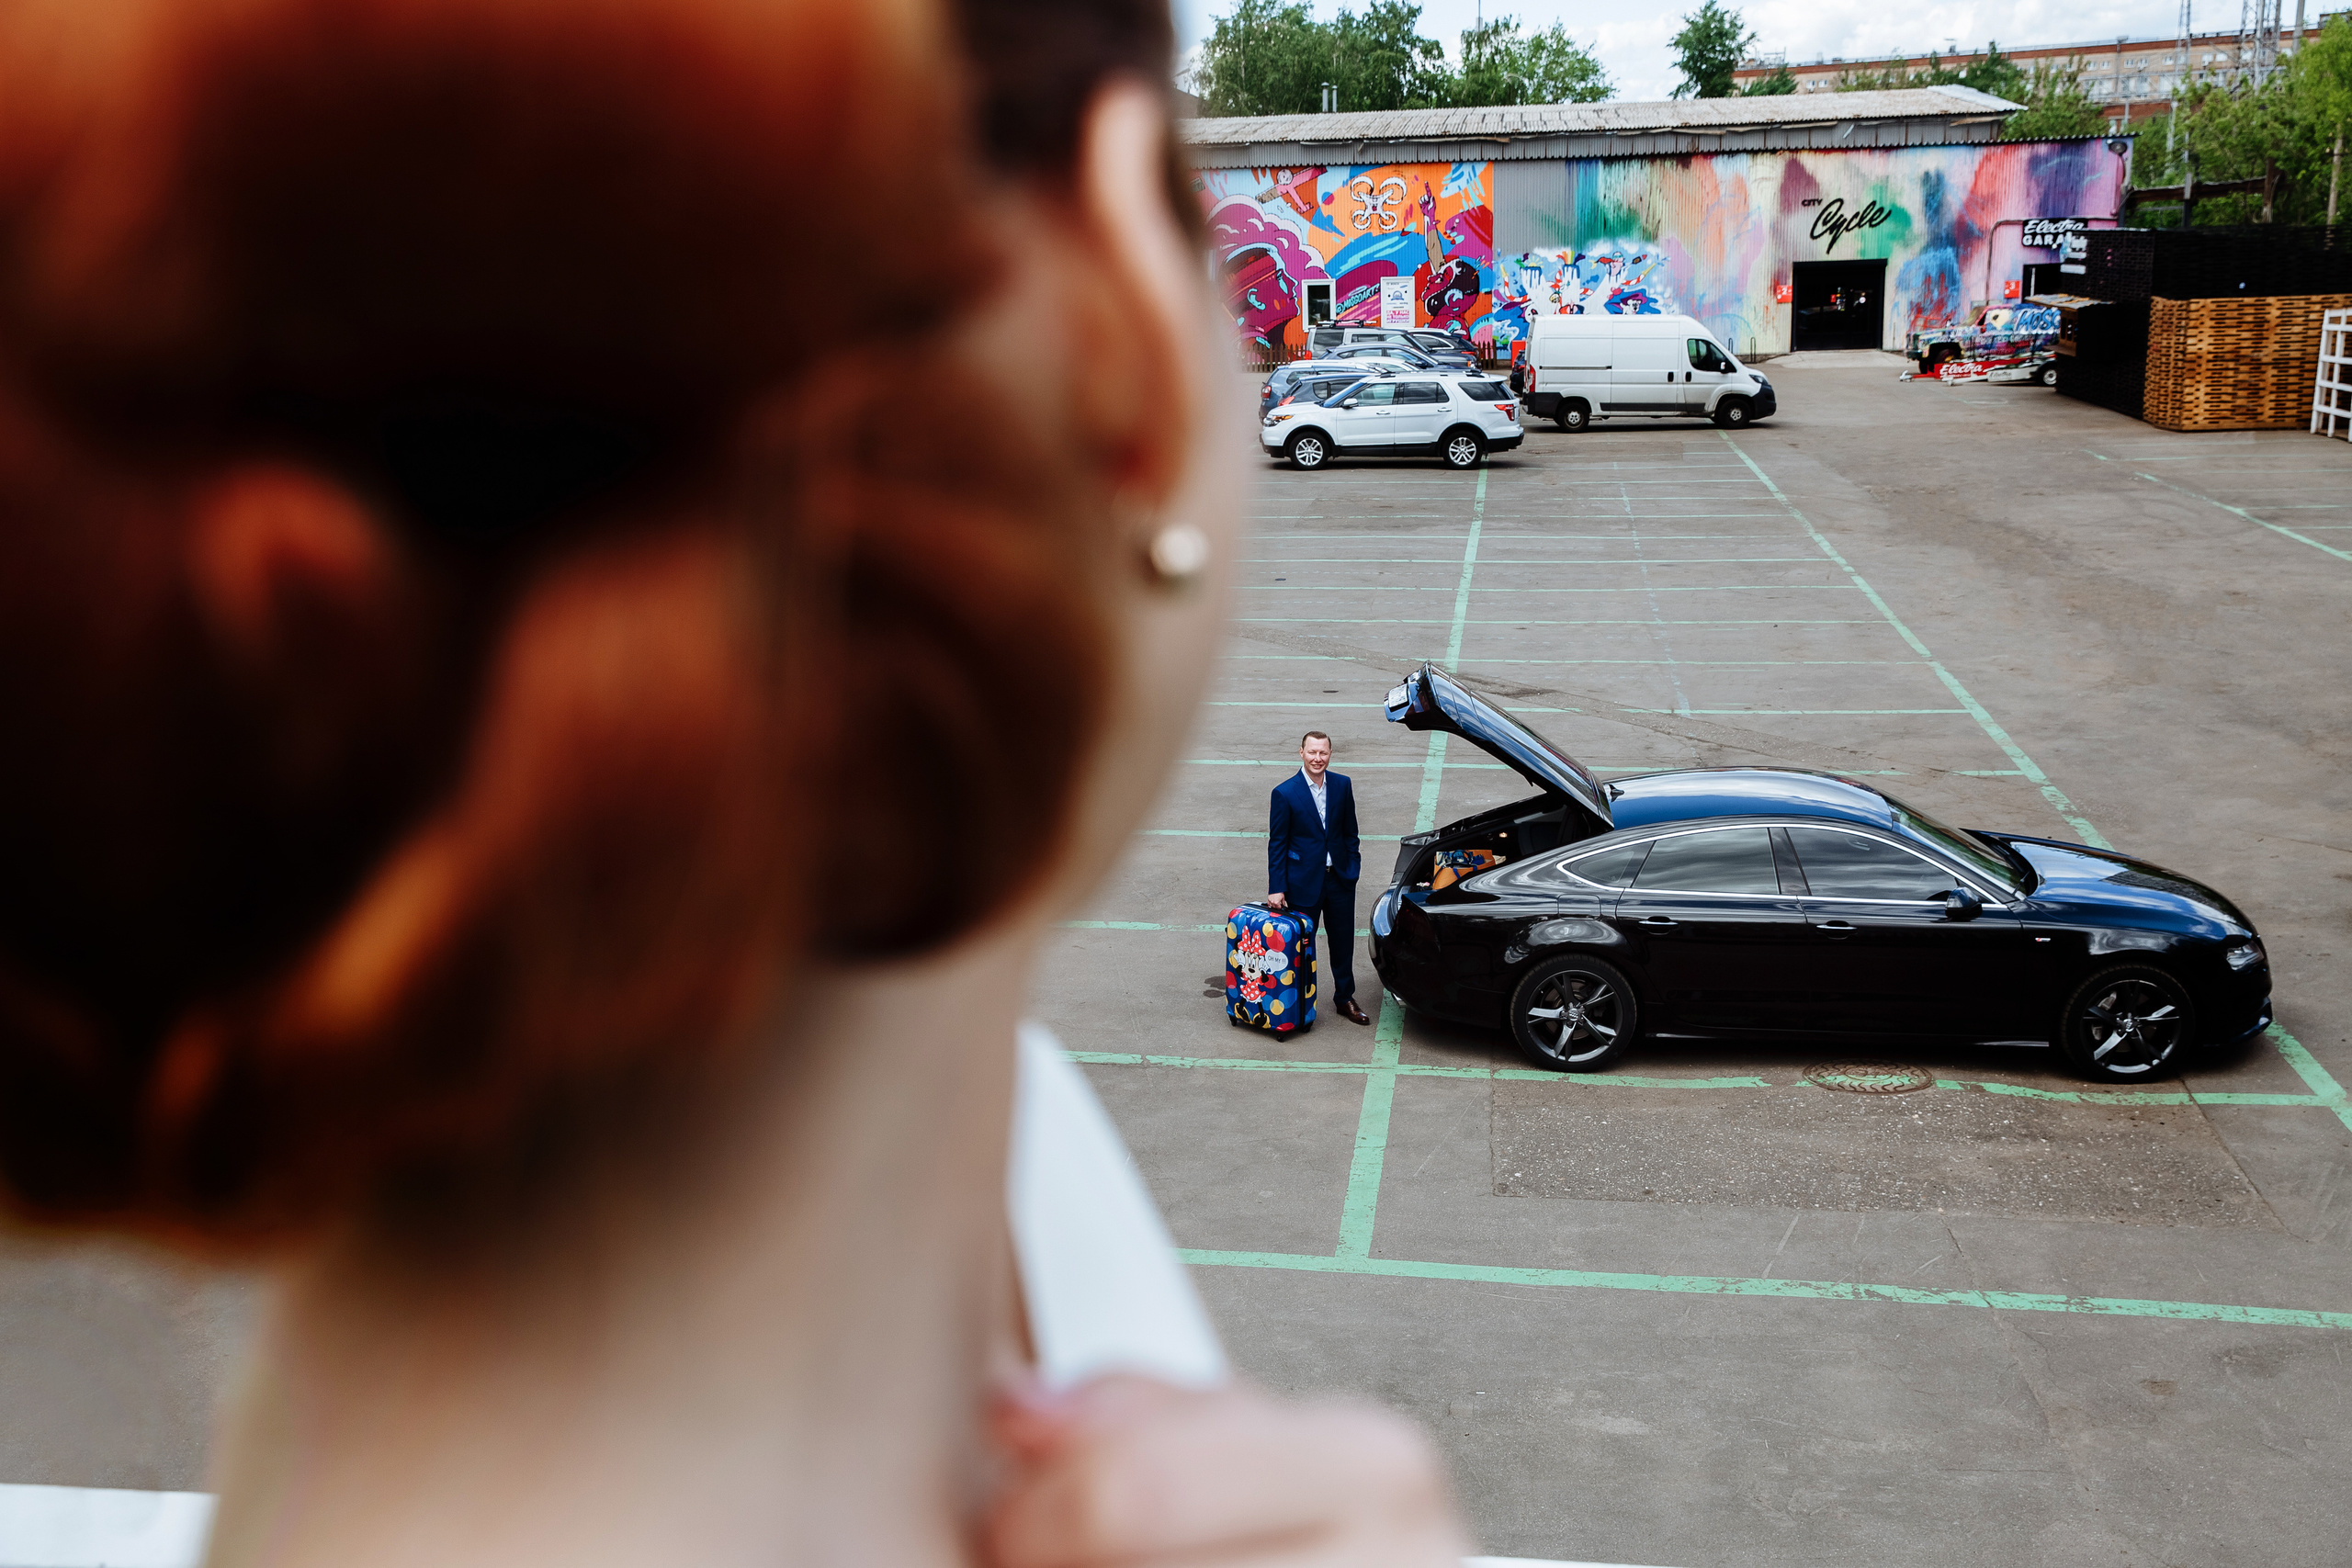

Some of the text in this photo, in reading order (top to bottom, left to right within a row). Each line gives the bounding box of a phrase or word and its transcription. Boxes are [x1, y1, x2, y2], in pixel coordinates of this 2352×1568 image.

[1802, 198, 1822, 207] CITY
[1810, 197, 1892, 254] Cycle
[2024, 219, 2086, 233] Electra
[2022, 233, 2064, 246] GARA
[2016, 309, 2062, 332] MOSC
[1939, 363, 1983, 375] Electra
